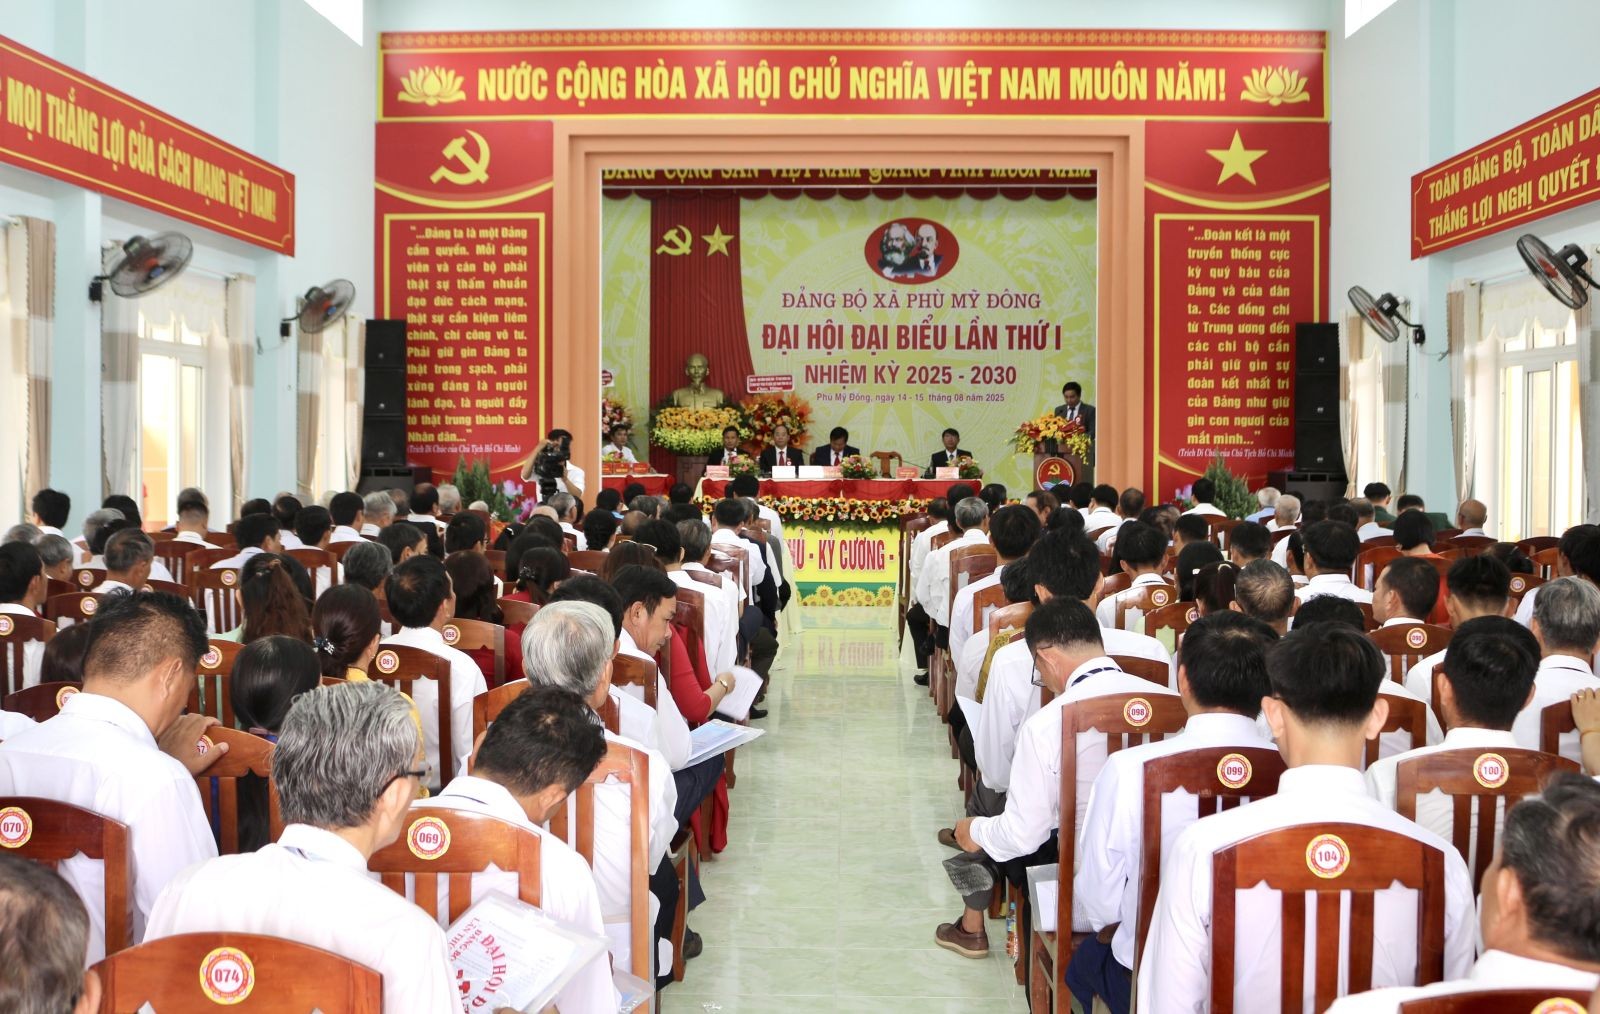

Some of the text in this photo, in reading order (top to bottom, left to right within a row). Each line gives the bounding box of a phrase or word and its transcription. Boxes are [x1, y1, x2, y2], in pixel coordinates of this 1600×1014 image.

[478, 55, 1227, 107] NƯỚC CỘNG HÒA XÃ HỘI CHỦ NGHĨA VIỆT NAM MUÔN NĂM!
[7, 76, 277, 223] MỌI THẮNG LỢI CỦA CÁCH MẠNG VIỆT NAM!
[1429, 172, 1460, 204] TOÀN
[1463, 156, 1499, 190] ĐẢNG
[1503, 140, 1527, 174] BỘ,
[1531, 122, 1573, 162] TOÀN
[1429, 153, 1590, 239] THẮNG LỢI NGHỊ QUYẾT
[782, 286, 1041, 312] ĐẢNG BỘ XÃ PHÙ MỸ ĐÔNG
[762, 314, 1062, 356] ĐẠI HỘI ĐẠI BIỂU LẦN THỨ I
[804, 360, 867, 389] NHIỆM
[874, 361, 900, 385] KỲ
[906, 365, 952, 385] 2025
[970, 365, 1018, 385] 2030
[818, 528, 836, 570] KỶ
[839, 537, 885, 571] CƯƠNG
[1131, 708, 1145, 716] 098
[1226, 766, 1243, 776] 099
[1483, 766, 1499, 775] 100
[3, 822, 22, 833] 070
[419, 832, 439, 845] 069
[1318, 850, 1338, 862] 104
[214, 969, 240, 983] 074
